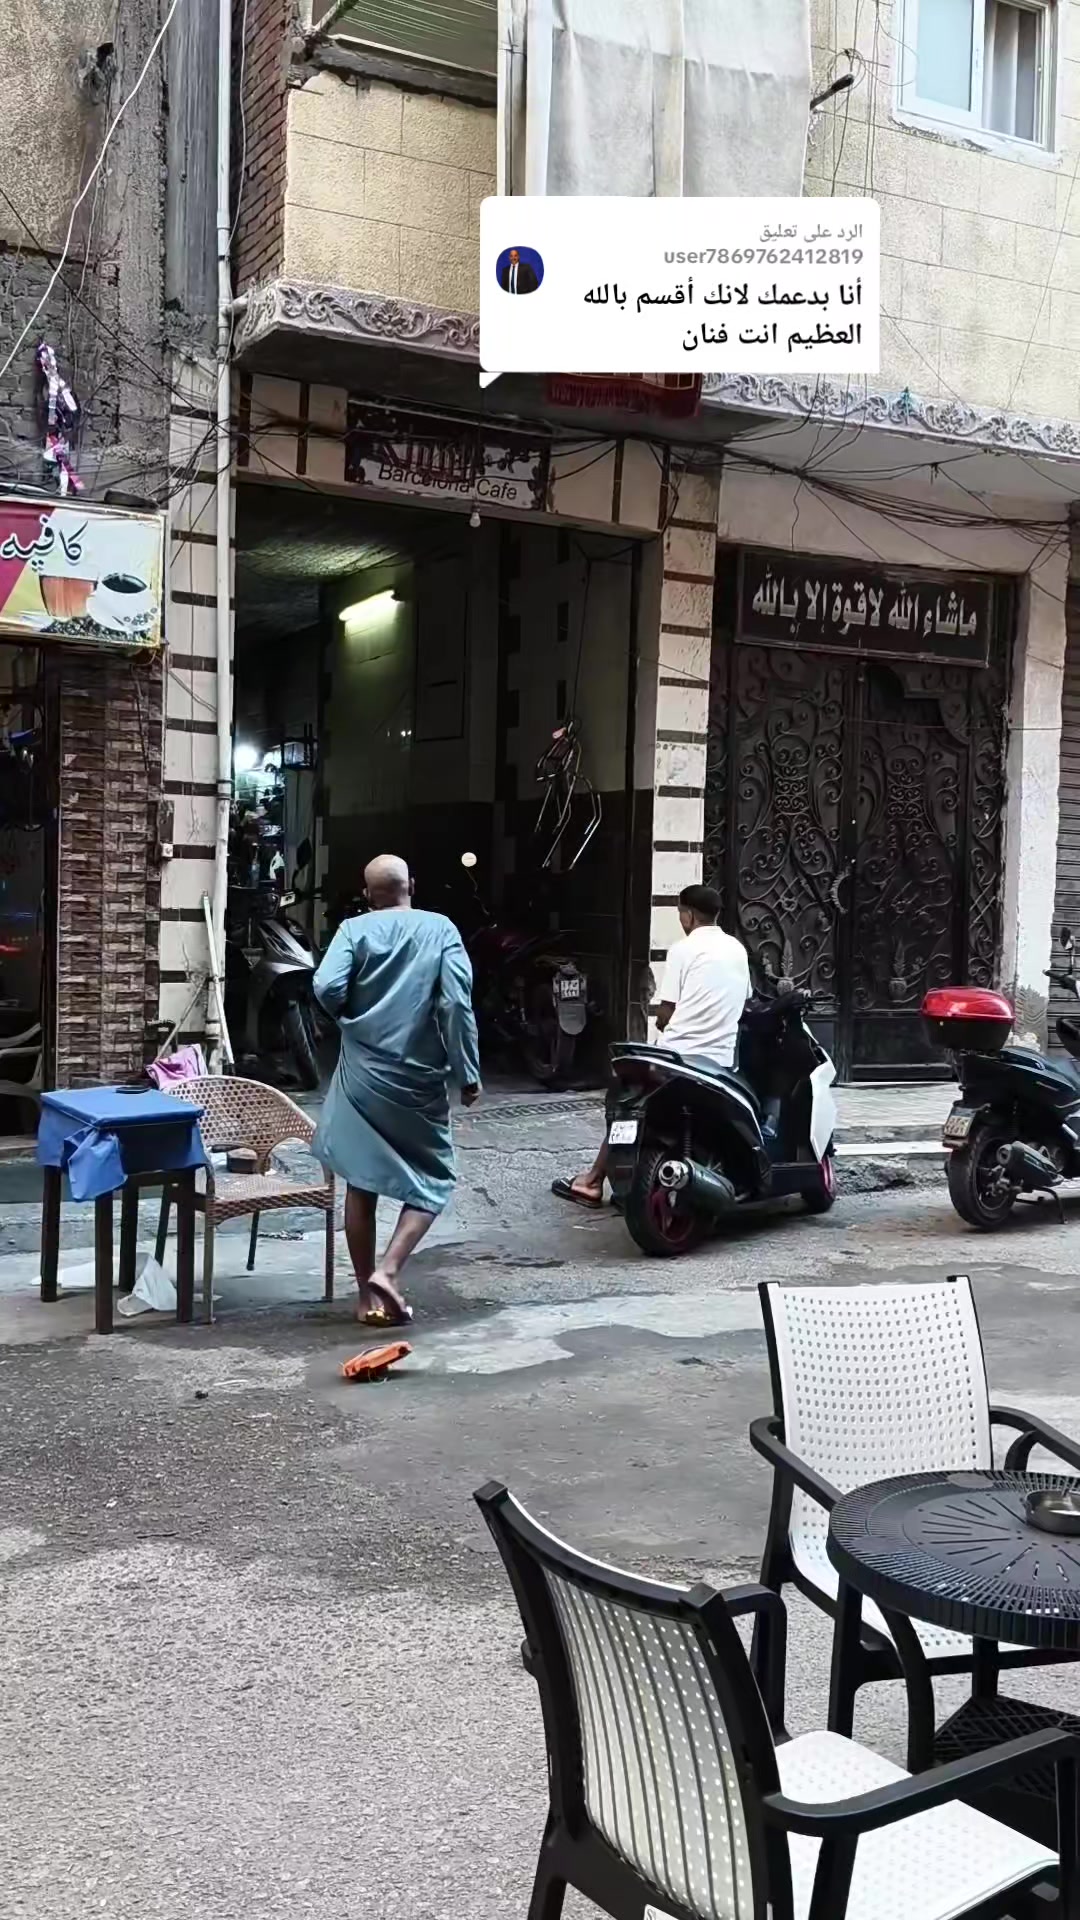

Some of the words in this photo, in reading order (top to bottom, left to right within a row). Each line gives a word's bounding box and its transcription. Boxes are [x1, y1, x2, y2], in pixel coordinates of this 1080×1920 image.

[476, 478, 518, 500] Cafe
[2, 516, 88, 568] كافيه
[888, 582, 920, 631] الله
